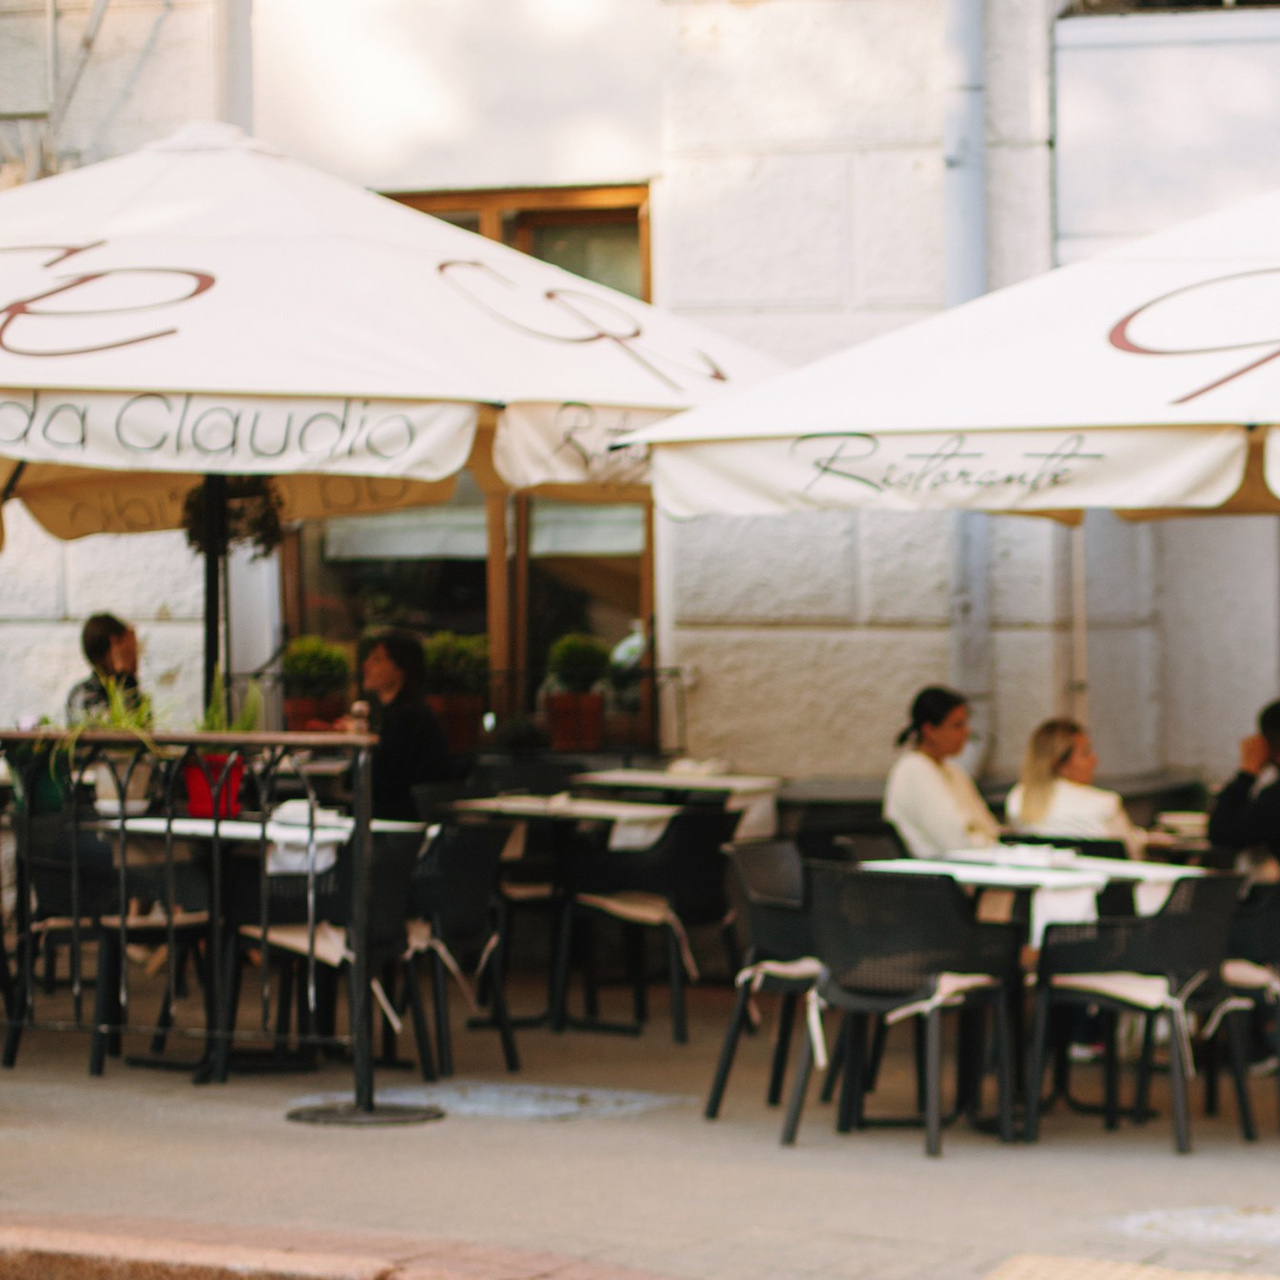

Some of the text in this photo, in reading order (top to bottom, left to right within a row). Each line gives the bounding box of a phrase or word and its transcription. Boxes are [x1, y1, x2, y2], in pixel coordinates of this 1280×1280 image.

[0, 389, 416, 459] da Claudio
[789, 431, 1106, 494] Ristorante
